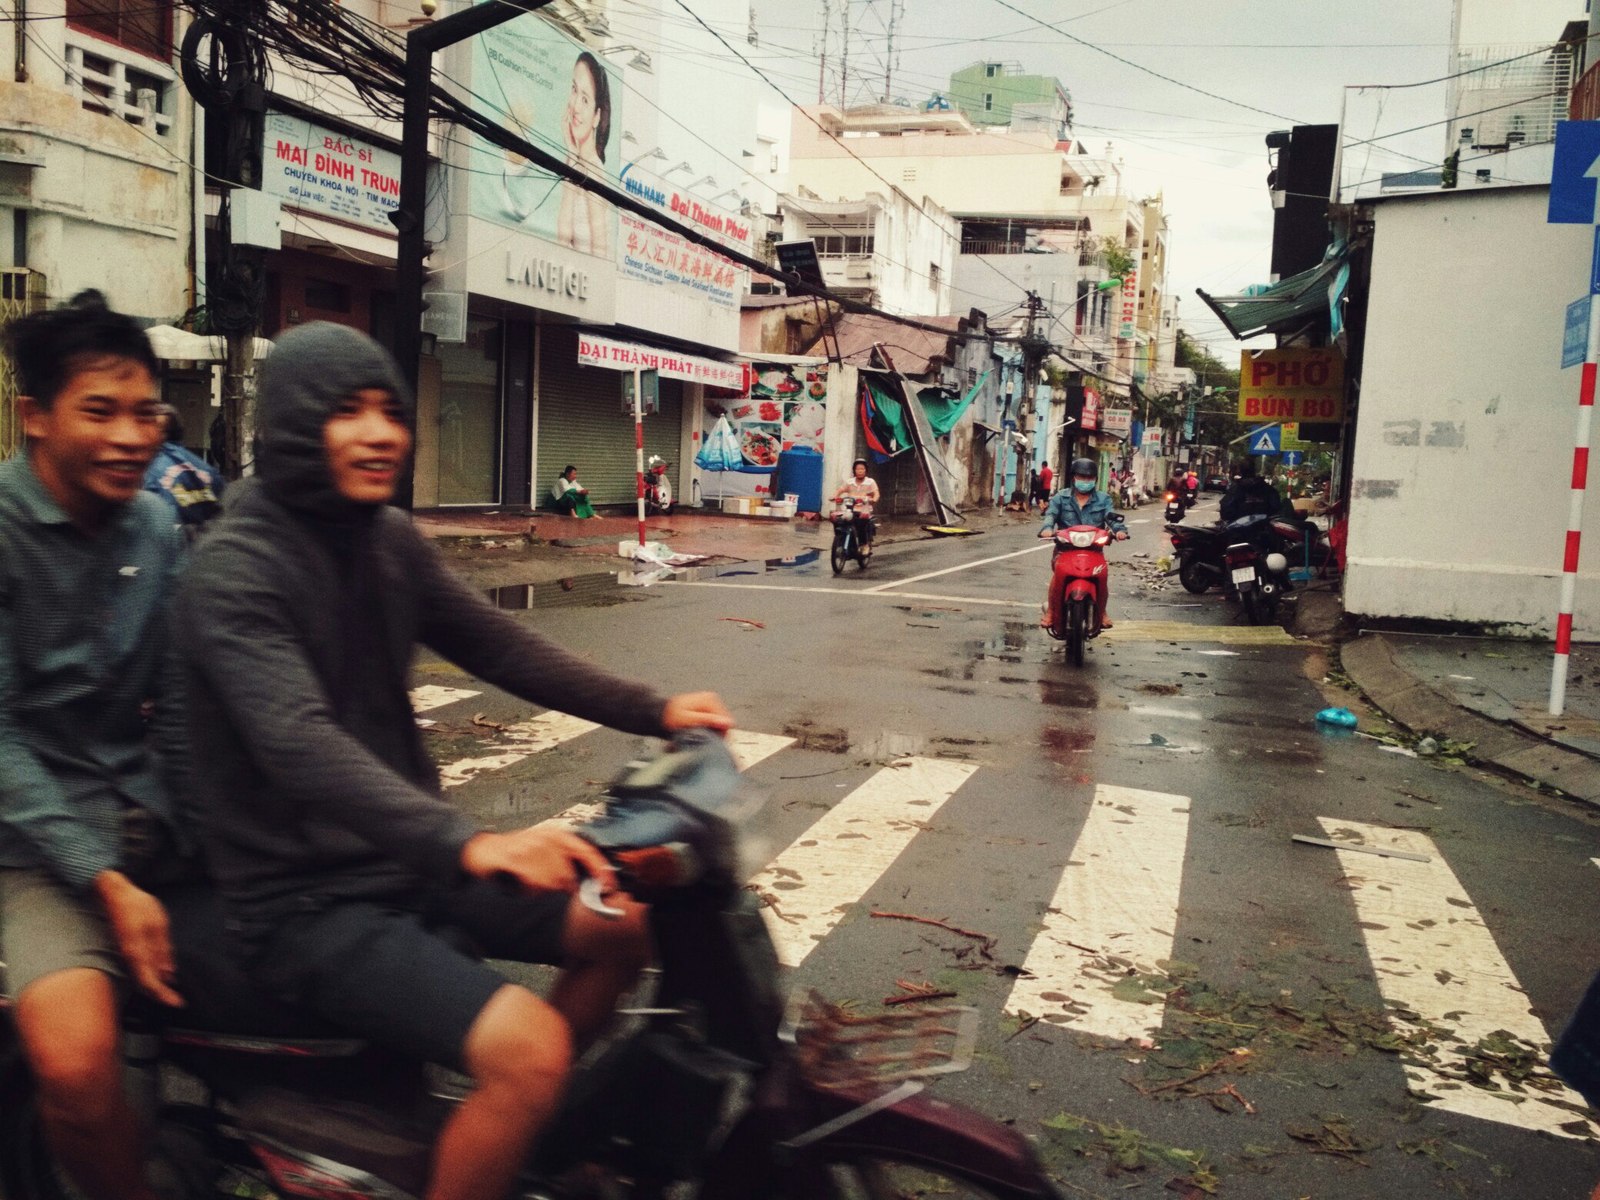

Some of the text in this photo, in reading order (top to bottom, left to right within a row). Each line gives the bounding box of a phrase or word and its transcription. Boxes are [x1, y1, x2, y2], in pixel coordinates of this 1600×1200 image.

[324, 137, 354, 156] BÁC
[276, 140, 401, 196] MAI ĐÌNH TRUN
[320, 178, 343, 191] KHOA
[366, 192, 379, 203] TIM
[506, 251, 587, 301] LANEIGE
[624, 255, 643, 270] Chinese
[580, 341, 608, 360] ĐẠI
[611, 347, 660, 368] THÀNH
[661, 356, 693, 374] PHÁT
[1252, 353, 1332, 387] PHỞ
[1245, 394, 1336, 418] BÚN BÒ
